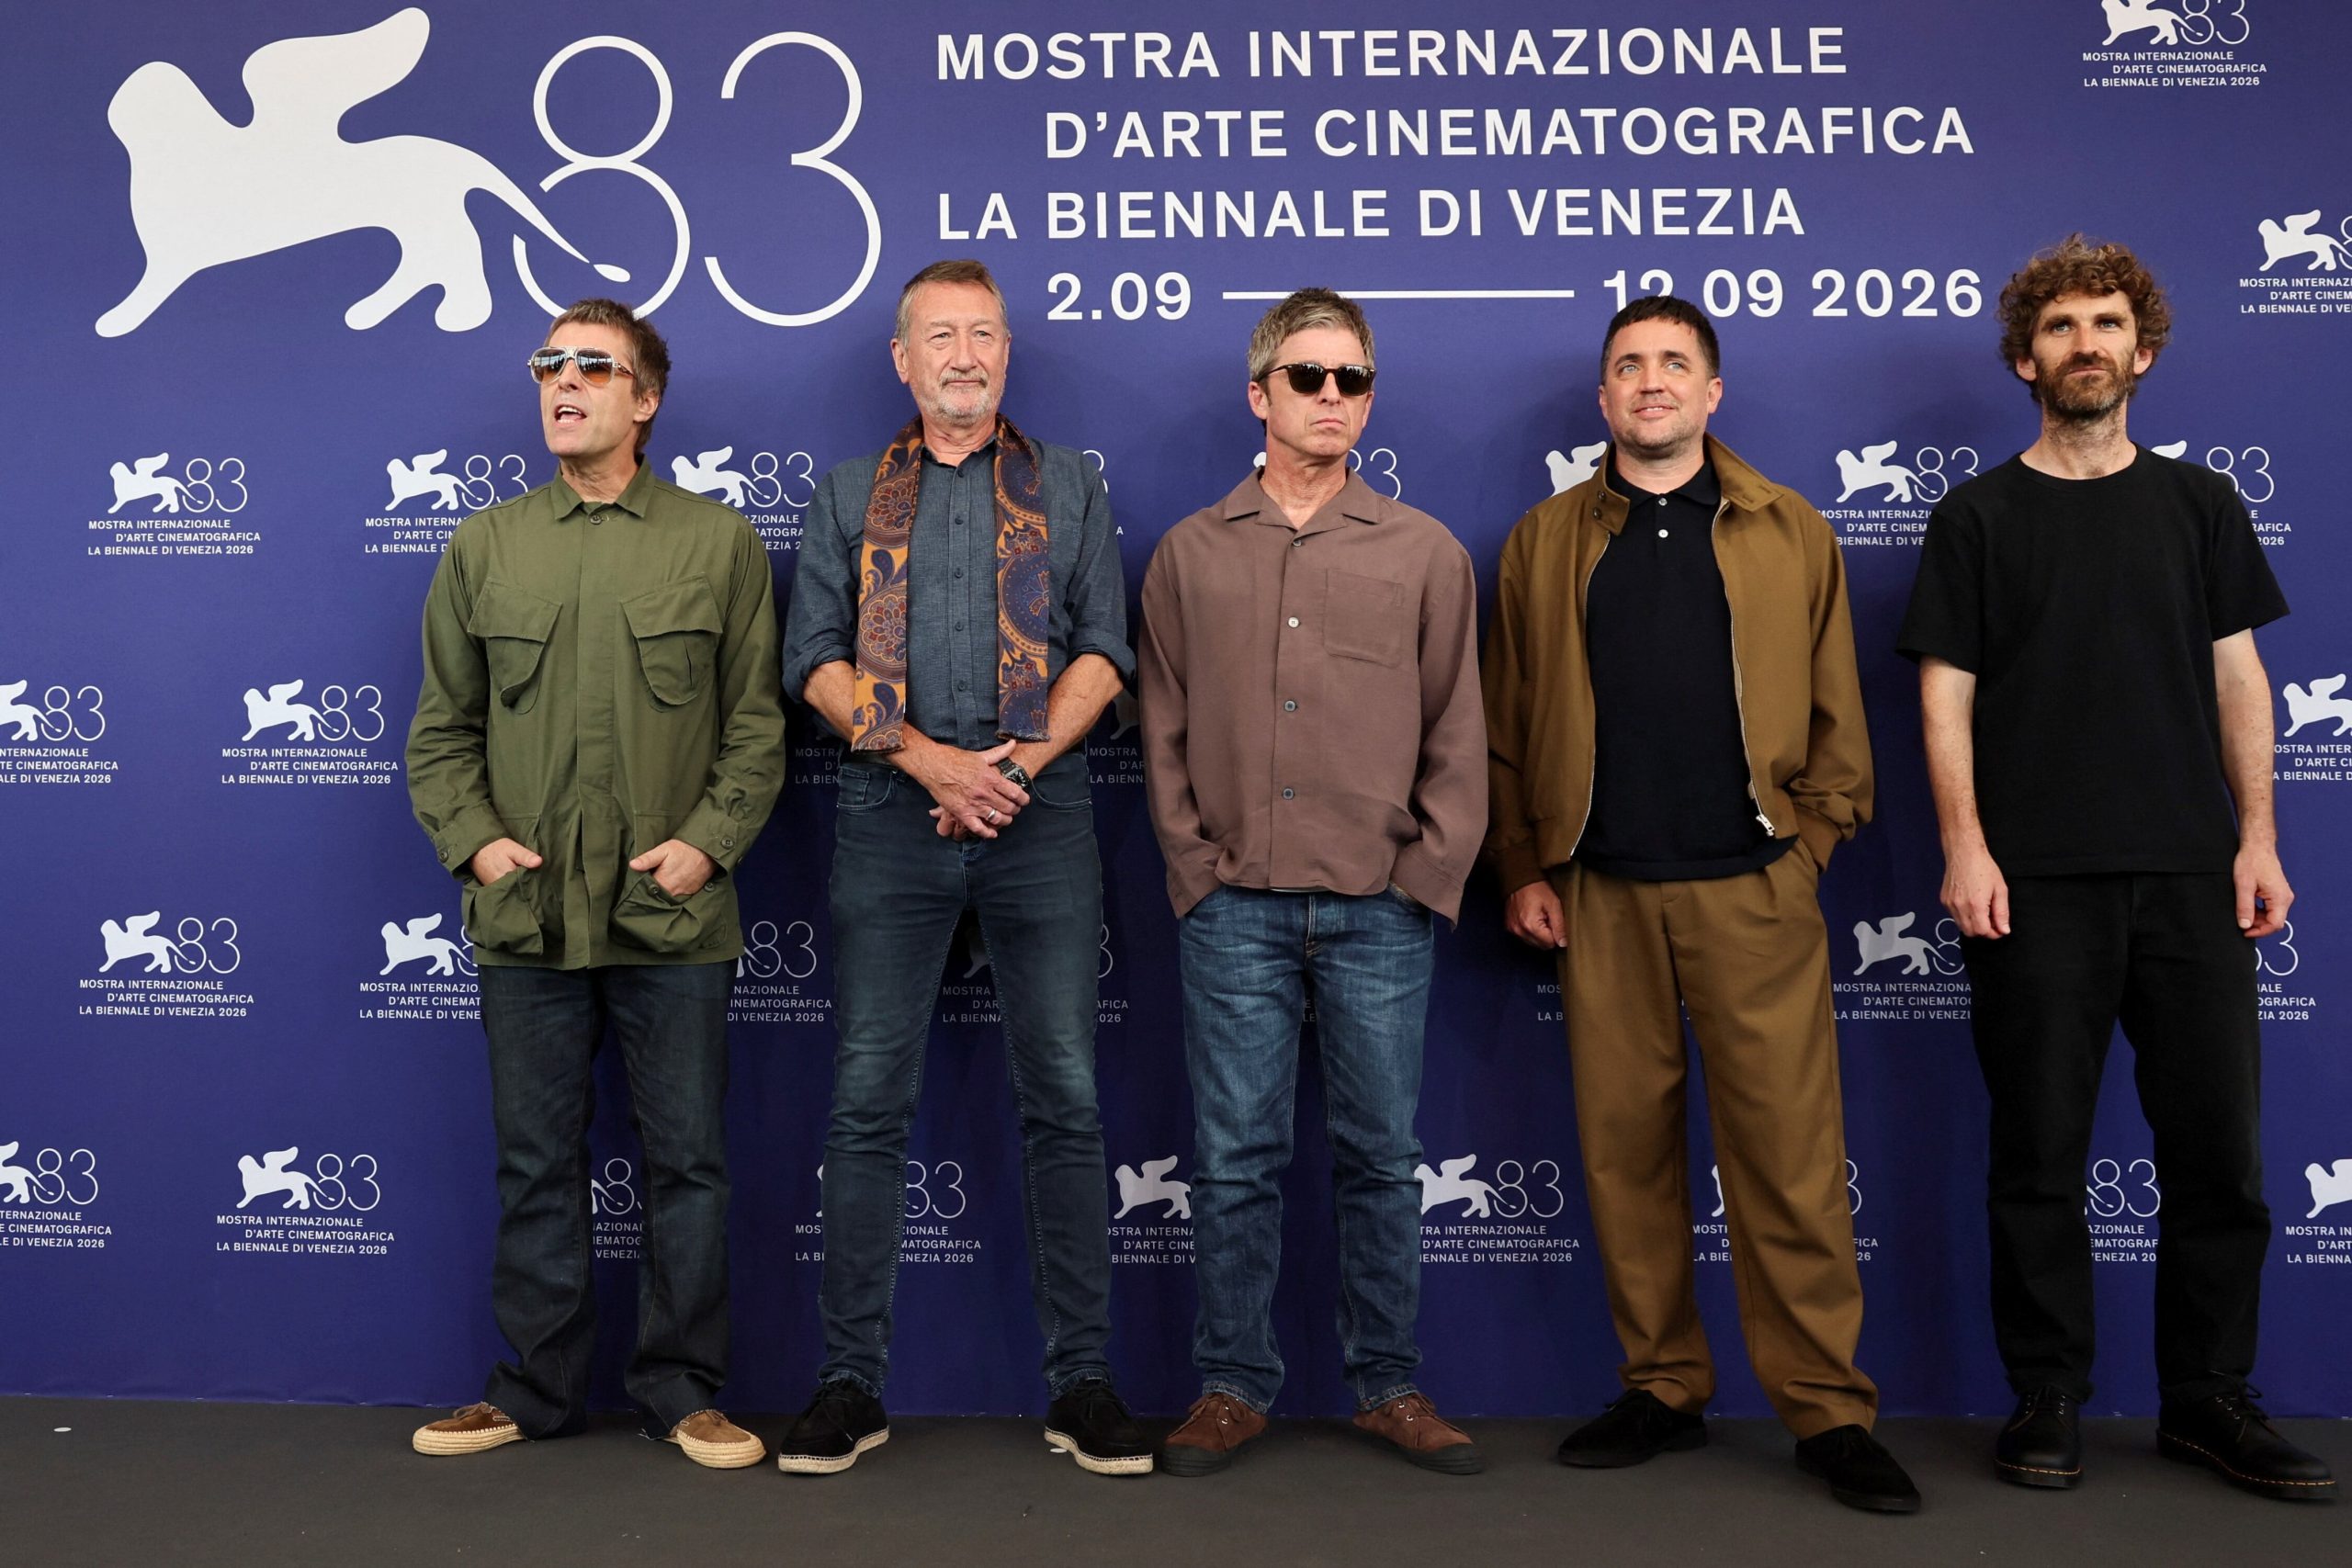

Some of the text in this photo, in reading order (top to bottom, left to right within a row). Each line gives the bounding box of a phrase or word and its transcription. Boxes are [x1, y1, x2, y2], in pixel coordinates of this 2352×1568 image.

[939, 28, 1846, 79] MOSTRA INTERNAZIONALE
[2083, 51, 2233, 62] MOSTRA INTERNAZIONALE
[2113, 63, 2267, 73] D'ARTE CINEMATOGRAFICA
[2084, 76, 2260, 86] LA BIENNALE DI VENEZIA 2026
[1047, 107, 1973, 158] D'ARTE CINEMATOGRAFICA
[513, 31, 881, 327] 83
[940, 188, 1804, 239] LA BIENNALE DI VENEZIA
[2240, 277, 2352, 288] MOSTRA INTERNAZ
[1048, 272, 1191, 320] 2.09
[1813, 269, 1982, 317] 2026
[2270, 291, 2312, 300] D'ARTE
[2241, 305, 2256, 313] LA
[2259, 304, 2317, 313] BIENNALE
[2321, 304, 2333, 313] DI
[1868, 510, 1931, 519] INTERNAZI
[89, 519, 231, 529] MOSTRA INTERNAZIONALE
[366, 517, 412, 526] MOSTRA
[1847, 523, 1887, 532] D'ARTE
[116, 532, 261, 542] D'ARTE CINEMATOGRAFICA
[393, 531, 433, 539] D'ARTE
[1896, 536, 1907, 545] DI
[2256, 536, 2285, 546] 2026
[88, 545, 254, 555] LA BIENNALE DI VENEZIA 2026
[365, 544, 437, 553] LA BIENNALE
[0, 748, 88, 757] NTERNAZIONALE
[222, 748, 368, 757] MOSTRA INTERNAZIONALE
[1090, 747, 1137, 757] MOSTRA
[2274, 744, 2312, 753] OSTRA
[16, 761, 119, 770] CINEMATOGRAFICA
[251, 761, 398, 771] D'ARTE CINEMATOGRAFICA
[2295, 758, 2336, 767] D'ARTE
[20, 774, 31, 783] DI
[34, 774, 80, 784] VENEZIA
[84, 774, 111, 784] 2026
[221, 774, 390, 784] LA BIENNALE DI VENEZIA 2026
[1090, 774, 1144, 784] LA BIENN
[2283, 772, 2342, 781] BIENNALE
[80, 979, 223, 990] MOSTRA INTERNAZIONALE
[360, 983, 478, 993] MOSTRA INTERNAZIO
[1833, 983, 1971, 992] MOSTRA INTERNAZIONA
[734, 986, 799, 995] NAZIONALE
[943, 987, 991, 996] MOSTRA
[107, 993, 254, 1003] D'ARTE CINEMATOGRAFICA
[389, 997, 428, 1006] D'ARTE
[1863, 997, 1905, 1006] D'ARTE
[730, 998, 831, 1009] INEMATOGRAFICA
[79, 1006, 246, 1017] LA BIENNALE DI VENEZIA 2026
[360, 1010, 481, 1020] LA BIENNALE DI VENE
[728, 1012, 824, 1021] DI VENEZIA 2026
[1538, 1012, 1552, 1021] LA
[1834, 1010, 1970, 1020] LA BIENNALE DI VENEZI
[2278, 1010, 2309, 1020] 2026
[943, 1013, 1001, 1022] LA BIENN
[1099, 1013, 1121, 1022] 026
[0, 1210, 82, 1221] TERNAZIONALE
[217, 1215, 363, 1227] MOSTRA INTERNAZIONALE
[8, 1224, 112, 1235] CINEMATOGRAFICA
[1107, 1226, 1141, 1236] STRA
[1445, 1225, 1546, 1235] INTERNAZIONALE
[1692, 1224, 1727, 1234] MOST
[2286, 1226, 2335, 1235] MOSTRA
[245, 1229, 394, 1241] D'ARTE CINEMATOGRAFICA
[13, 1237, 24, 1246] DI
[27, 1237, 74, 1247] VENEZIA
[77, 1238, 105, 1248] 2026
[901, 1239, 981, 1249] MATOGRAFICA
[1124, 1241, 1164, 1249] D'ARTE
[1422, 1239, 1579, 1249] D'ARTE CINEMATOGRAFICA
[2317, 1240, 2352, 1249] D'ART
[217, 1242, 387, 1255] LA BIENNALE DI VENEZIA 2026
[796, 1252, 809, 1261] LA
[899, 1253, 974, 1263] ENEZIA 2026
[1112, 1254, 1170, 1263] BIENNALE
[1174, 1255, 1185, 1263] DI
[1419, 1253, 1572, 1263] IENNALE DI VENEZIA 2026
[2091, 1252, 2138, 1261] ENEZIA
[2287, 1254, 2352, 1264] LA BIENNA
